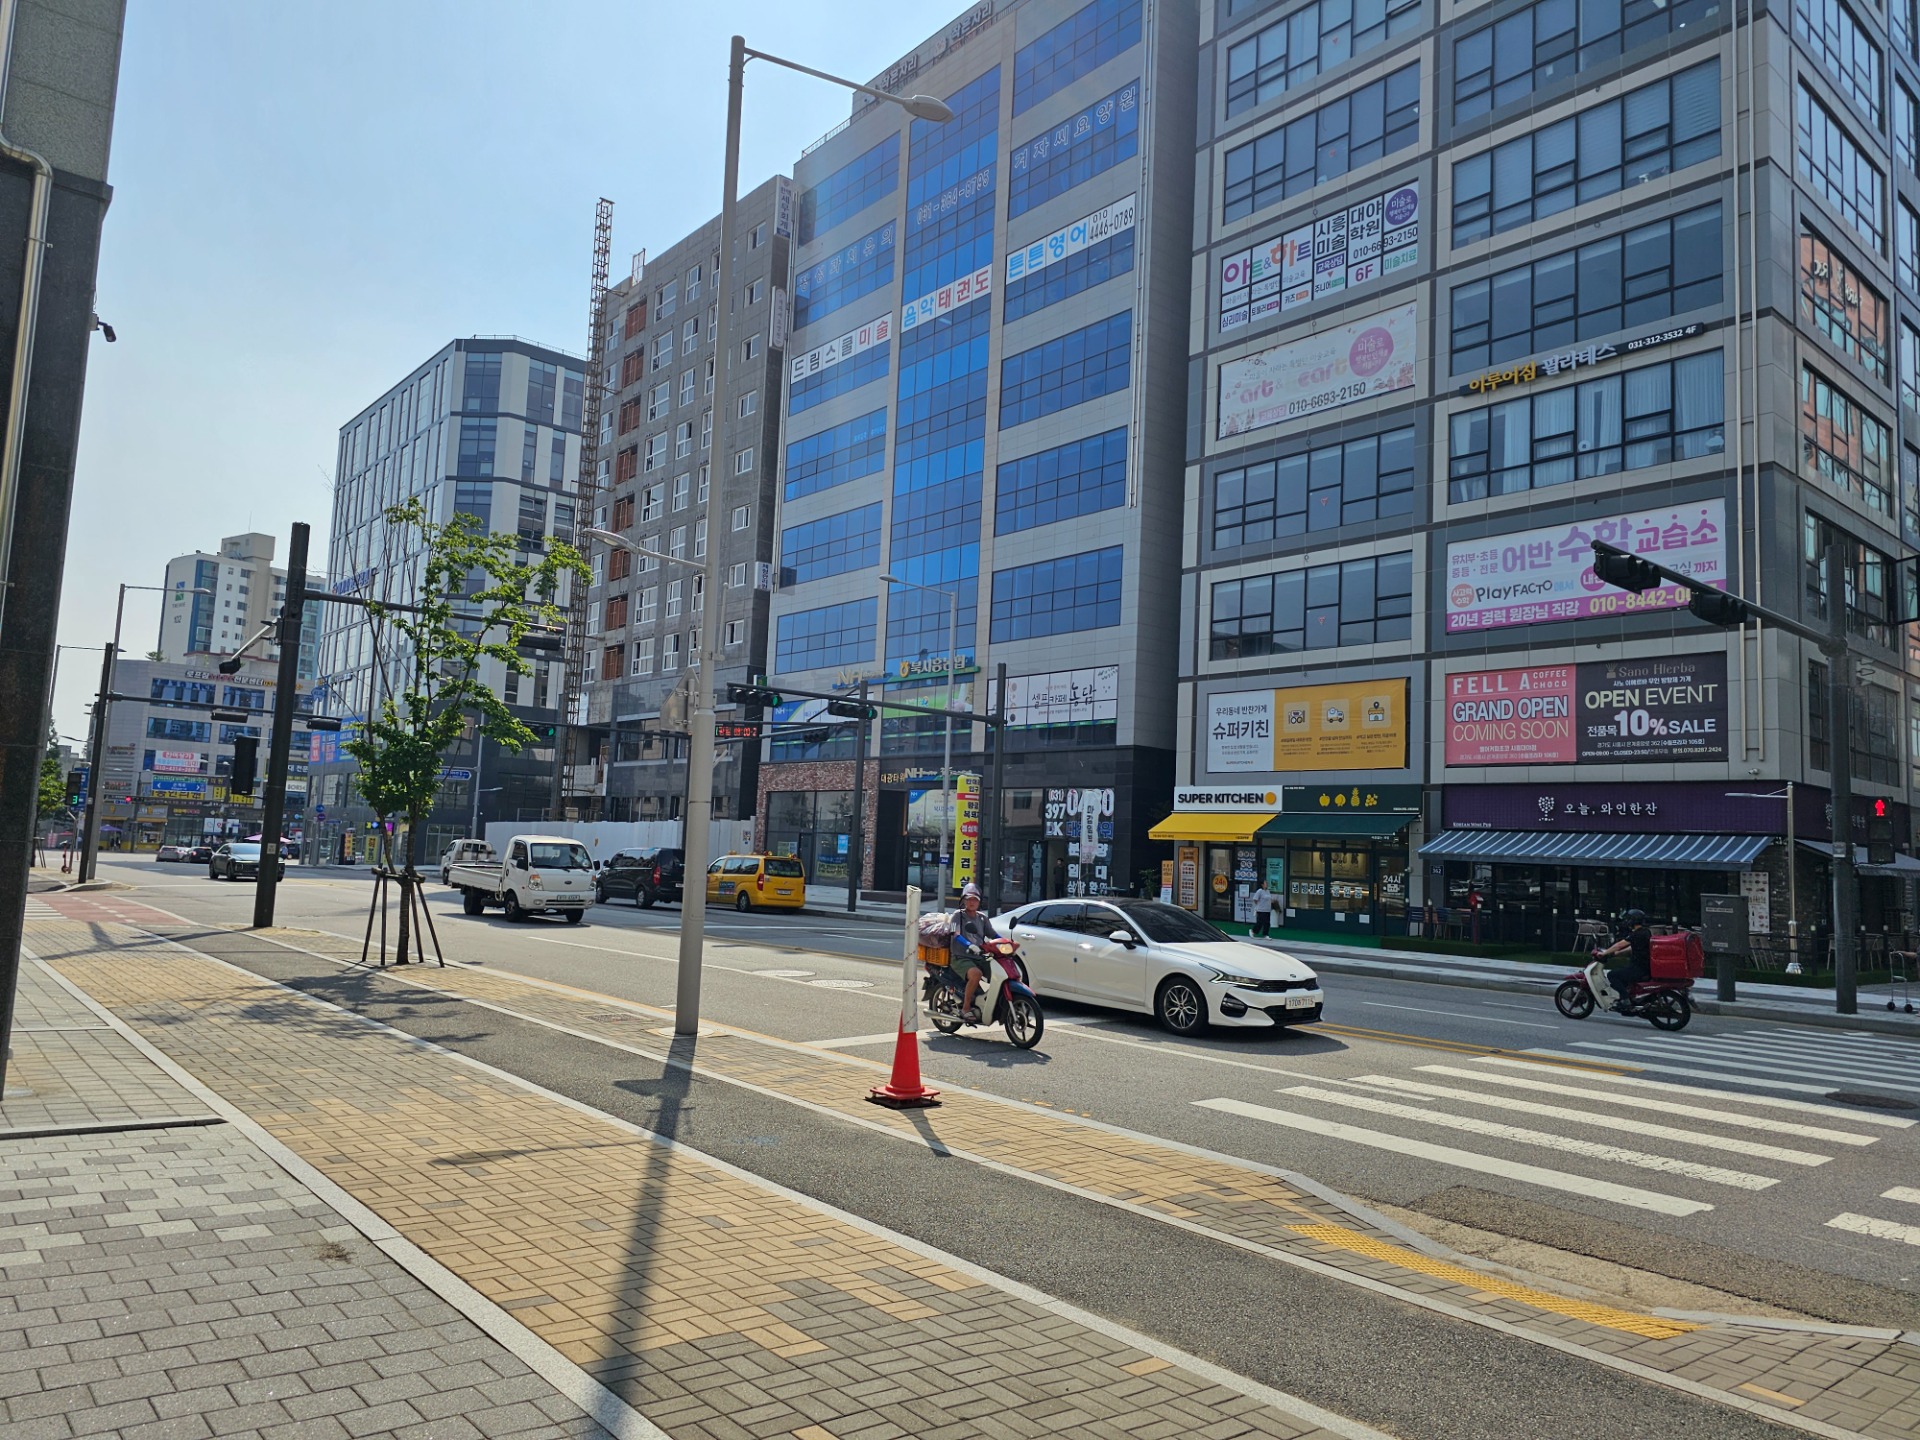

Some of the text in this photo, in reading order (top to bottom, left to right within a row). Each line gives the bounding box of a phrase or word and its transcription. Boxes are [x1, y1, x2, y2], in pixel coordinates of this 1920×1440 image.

[1014, 87, 1136, 169] 겨자씨요양원
[1089, 206, 1135, 241] 4446-0789
[1350, 200, 1382, 225] 대야
[1316, 218, 1380, 256] 미술 학원
[1353, 227, 1418, 259] 010-6693-2150
[1384, 248, 1417, 270] 미술치료
[1355, 263, 1374, 282] 6F
[937, 269, 991, 310] 태권도
[1628, 330, 1683, 350] 031-312-3532
[1685, 325, 1697, 336] 4F
[1288, 381, 1367, 415] 010-6693-2150
[1502, 541, 1554, 573] 어반
[1634, 508, 1719, 553] 교습소
[1693, 560, 1718, 573] 까지
[1451, 600, 1580, 628] 20년 경력 원장님 직강
[836, 668, 863, 685] NH
[1532, 669, 1568, 680] COFFEE
[1618, 666, 1649, 678] Sano
[1453, 672, 1530, 695] FELL A
[1532, 680, 1568, 690] CHOCO
[1585, 684, 1718, 710] OPEN EVENT
[1216, 704, 1267, 716] 우리동네 반찬가게
[1452, 694, 1569, 723] GRAND OPEN
[1212, 719, 1269, 740] 슈퍼키친
[1452, 719, 1569, 743] COMING SOON
[1587, 709, 1716, 737] 전품목 10% SALE
[905, 767, 923, 778] NH
[1048, 788, 1065, 801] (031)
[1178, 792, 1264, 804] SUPER KITCHEN
[1045, 803, 1066, 819] 397
[1563, 801, 1658, 816] 오늘, 와인한잔
[1046, 821, 1063, 836] DK
